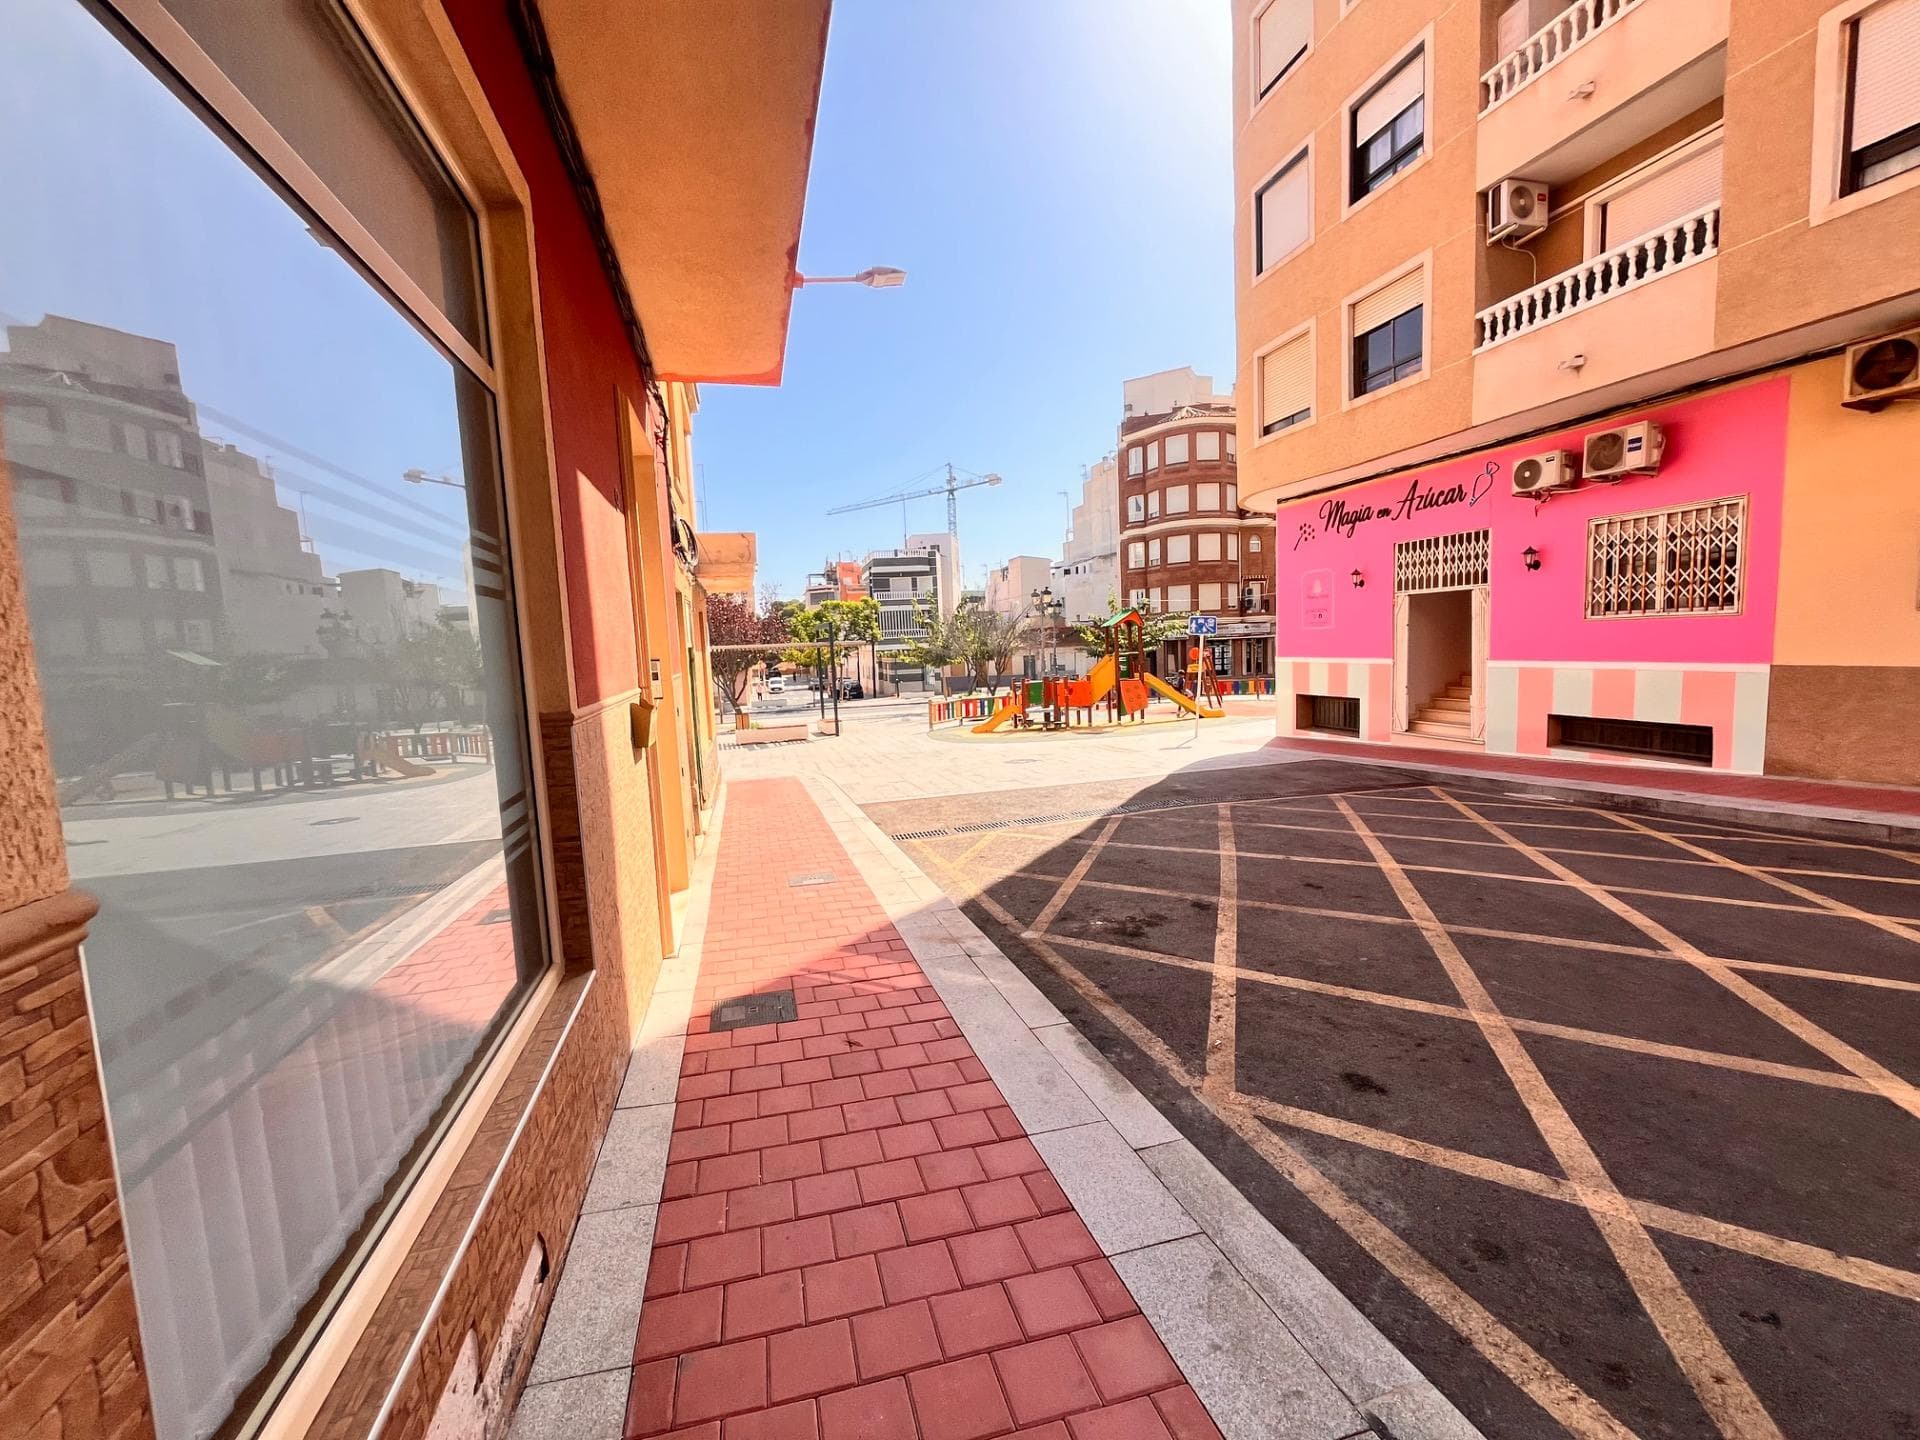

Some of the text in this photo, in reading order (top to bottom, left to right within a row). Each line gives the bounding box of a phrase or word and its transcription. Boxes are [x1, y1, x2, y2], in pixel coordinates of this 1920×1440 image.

[1320, 479, 1467, 538] Magia en Azúcar
